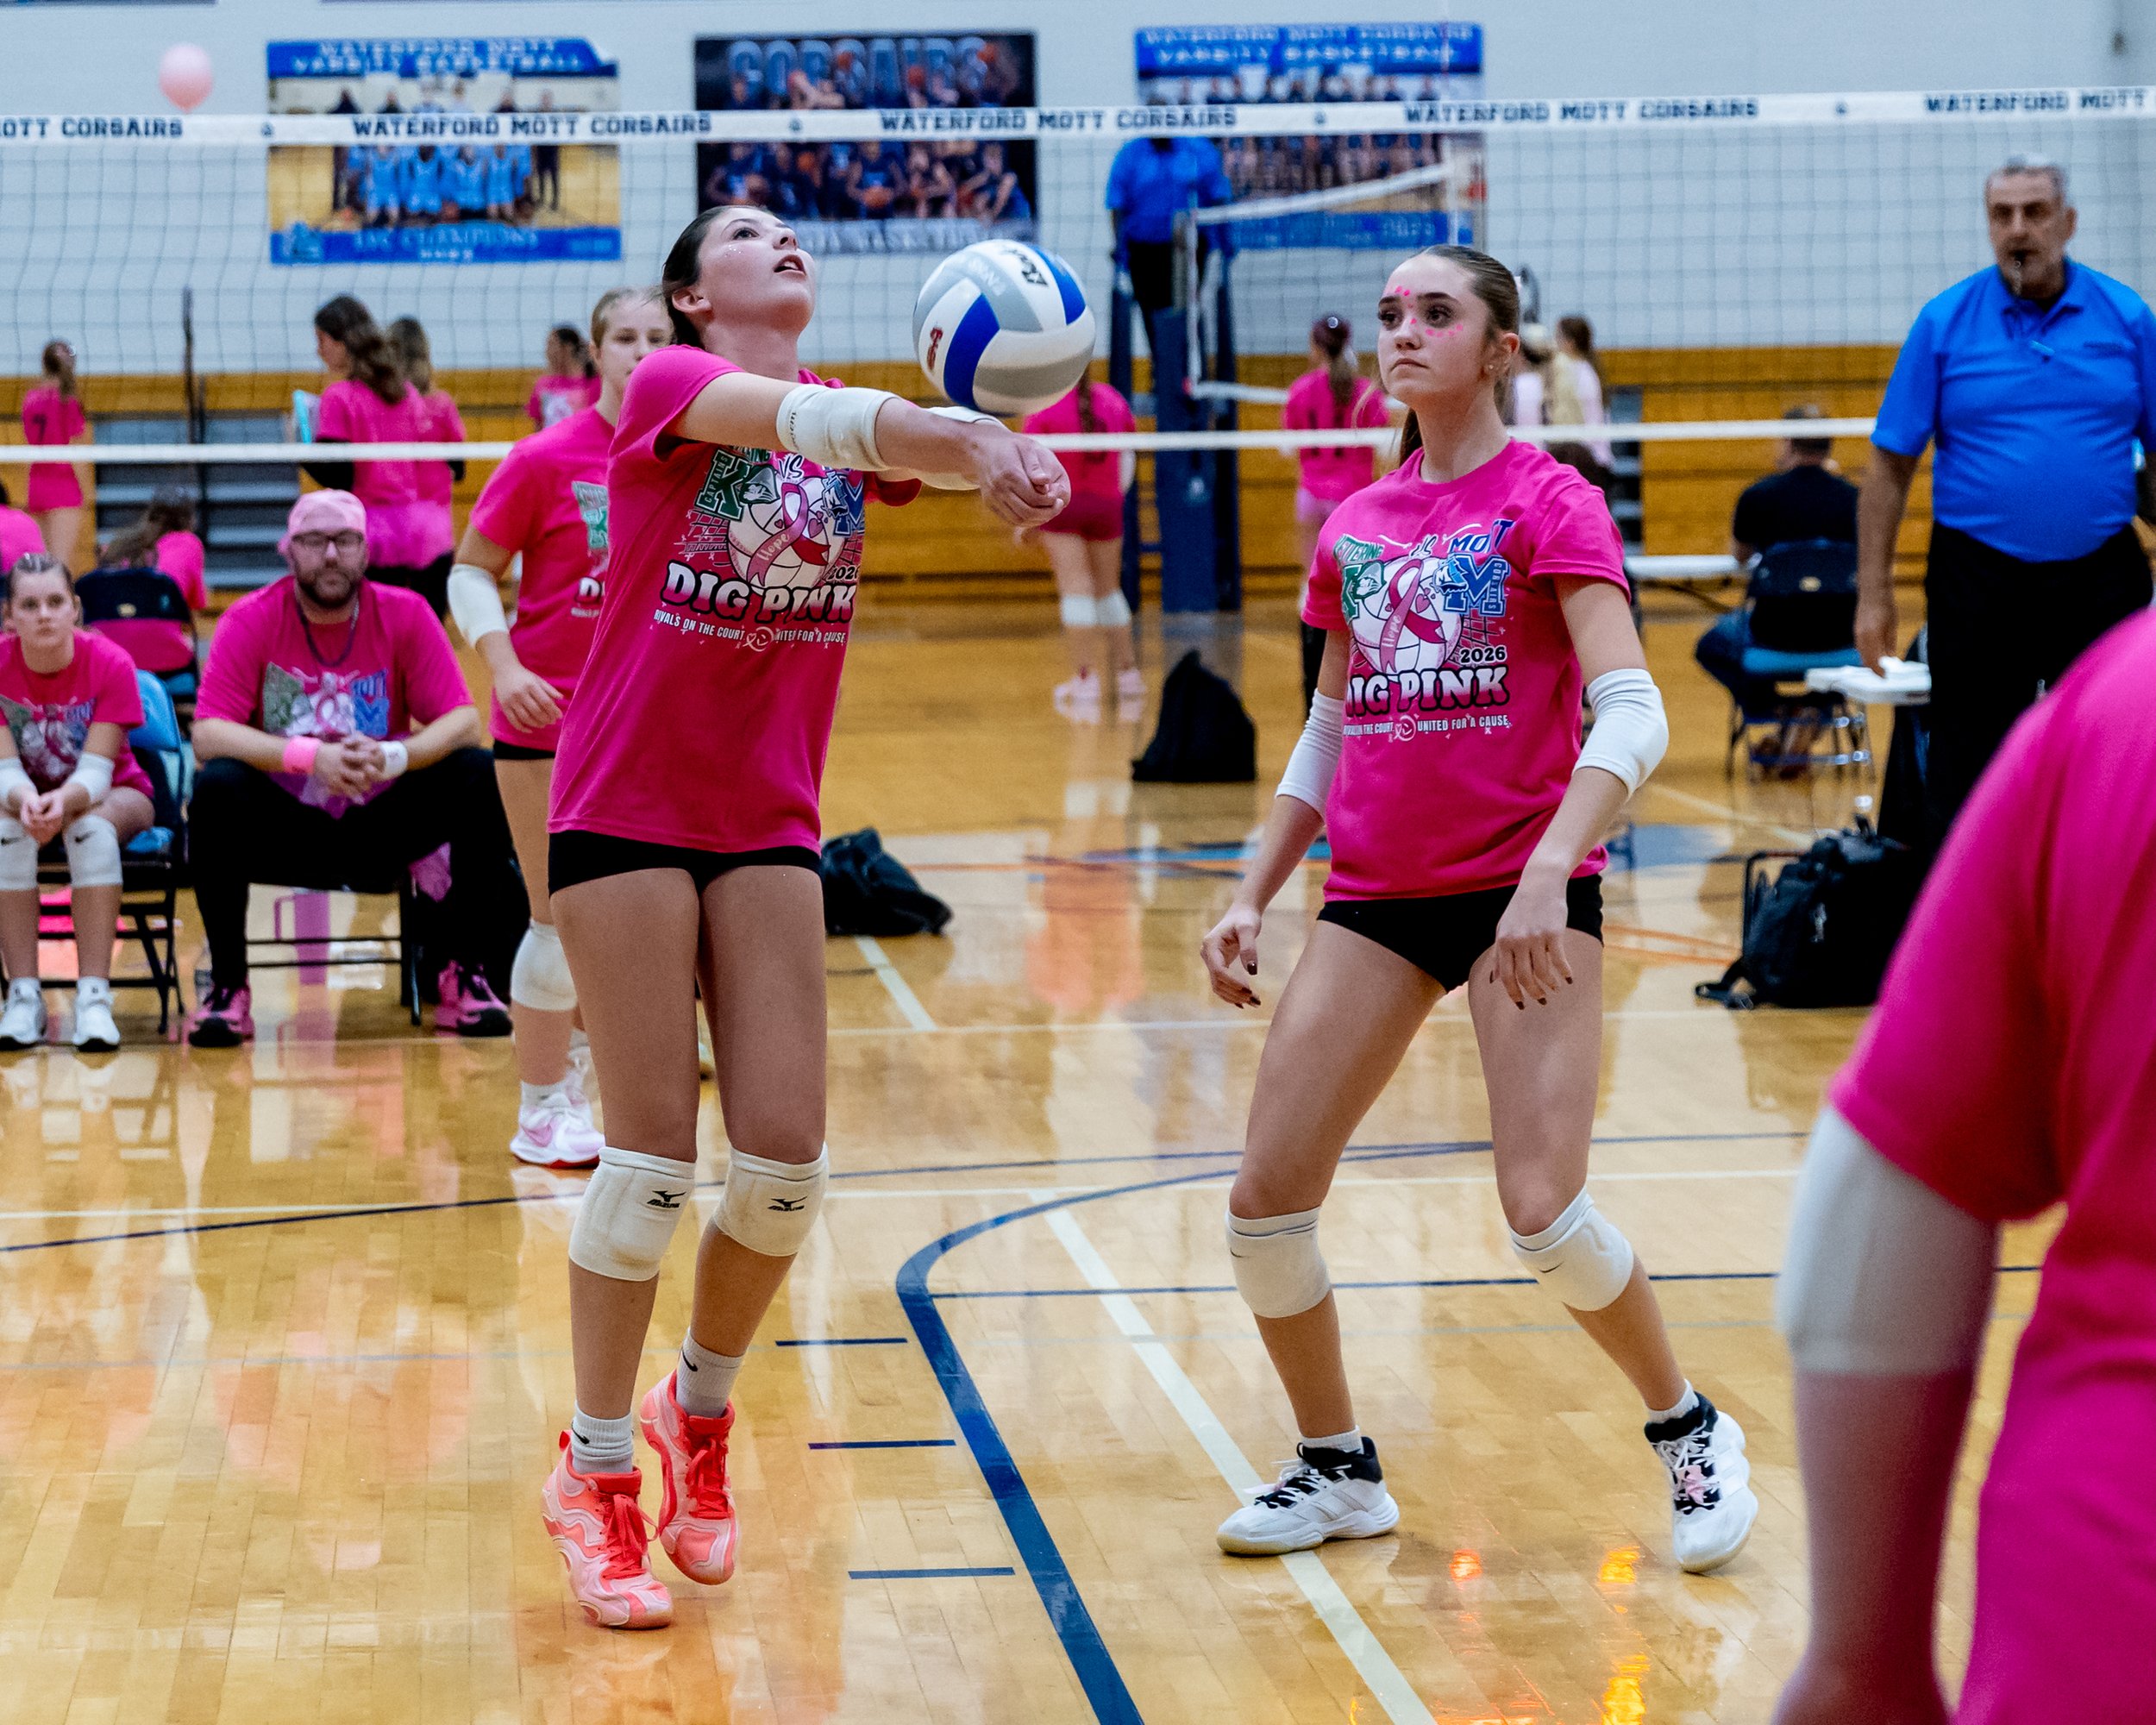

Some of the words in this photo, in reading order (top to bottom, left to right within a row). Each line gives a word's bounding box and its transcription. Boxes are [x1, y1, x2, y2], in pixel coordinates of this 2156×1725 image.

[1404, 102, 1550, 122] WATERFORD
[1559, 102, 1627, 121] MOTT
[1640, 98, 1759, 119] CORSAIRS
[1925, 92, 2069, 112] WATERFORD
[2079, 88, 2145, 109] MOTT
[0, 117, 51, 138] OTT
[61, 116, 183, 139] CORSAIRS
[352, 116, 499, 137] WATERFORD
[511, 115, 579, 136] MOTT
[590, 112, 713, 135] CORSAIRS
[881, 110, 1027, 131] WATERFORD
[1037, 110, 1104, 129] MOTT
[1116, 106, 1237, 129] CORSAIRS
[779, 453, 804, 479] VS
[704, 455, 729, 504] CAPTAINS
[756, 533, 790, 561] Hope
[661, 559, 752, 621] DIG
[755, 583, 857, 624] PINK
[1488, 562, 1503, 610] CORSAIRS
[654, 609, 681, 627] RIVALS
[683, 618, 697, 631] ON
[699, 622, 716, 636] THE
[797, 630, 814, 643] FOR
[1382, 614, 1401, 647] Hope
[1460, 646, 1506, 664] 2026
[1397, 663, 1510, 712] PINK
[1417, 719, 1448, 731] UNITED
[1451, 718, 1467, 730] FOR
[1470, 717, 1476, 728] A
